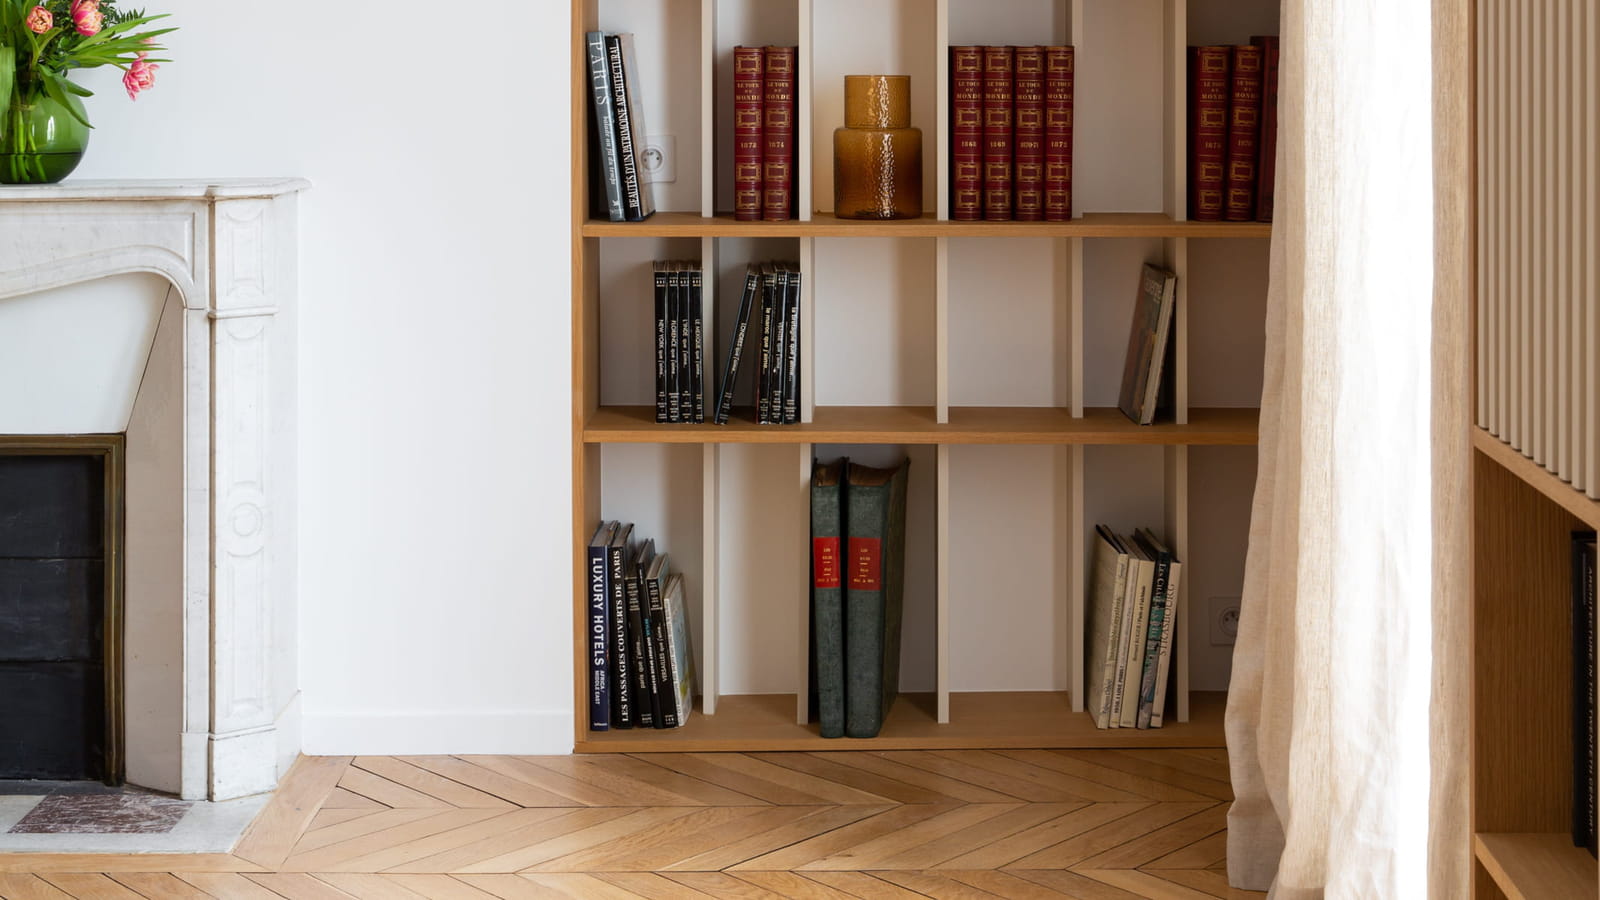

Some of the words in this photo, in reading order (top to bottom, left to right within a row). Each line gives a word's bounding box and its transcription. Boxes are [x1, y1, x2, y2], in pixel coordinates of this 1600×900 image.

[589, 41, 608, 105] PARIS
[619, 107, 632, 153] PATRIMOINE
[737, 323, 746, 347] LONDRES
[789, 314, 797, 341] bretagne
[788, 343, 796, 356] que
[613, 550, 621, 579] PARIS
[592, 557, 604, 611] LUXURY
[615, 583, 622, 597] DE
[616, 600, 625, 652] COUVERTS
[1158, 583, 1176, 657] STRASBOURG
[594, 615, 605, 666] HOTELS
[618, 653, 628, 702] PASSAGES
[658, 652, 668, 682] VERSAILLES
[1588, 664, 1593, 679] IN
[620, 704, 629, 722] LES
